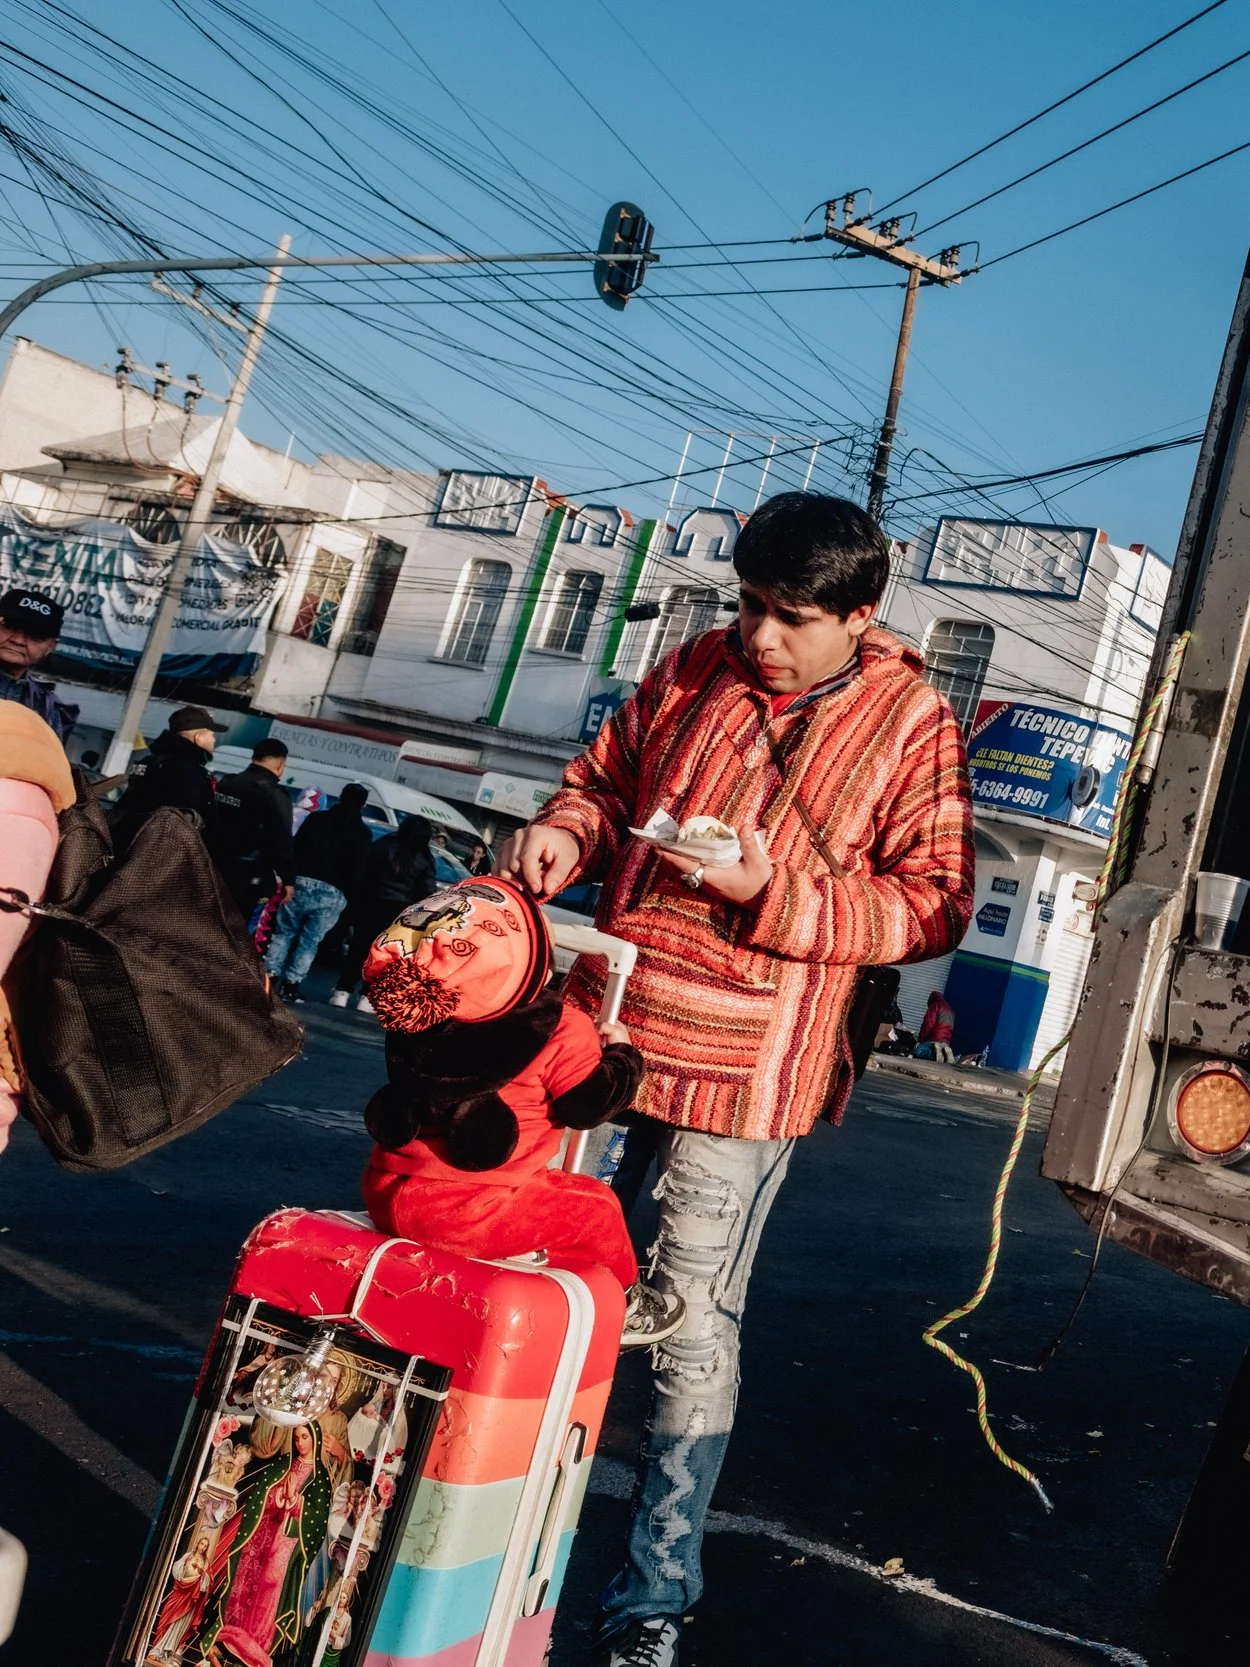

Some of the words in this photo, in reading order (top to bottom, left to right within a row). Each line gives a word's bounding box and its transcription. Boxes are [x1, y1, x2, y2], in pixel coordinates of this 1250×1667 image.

[19, 597, 51, 615] D&G
[971, 703, 1009, 738] ABIERTO
[1009, 708, 1090, 744] TÉCNICO
[988, 749, 1014, 763] FALTAN
[1014, 753, 1055, 771] DIENTES?
[997, 761, 1006, 771] SE
[1006, 763, 1019, 773] LOS
[1019, 766, 1052, 781] PONEMOS
[971, 778, 1050, 809] 5-6364-9991
